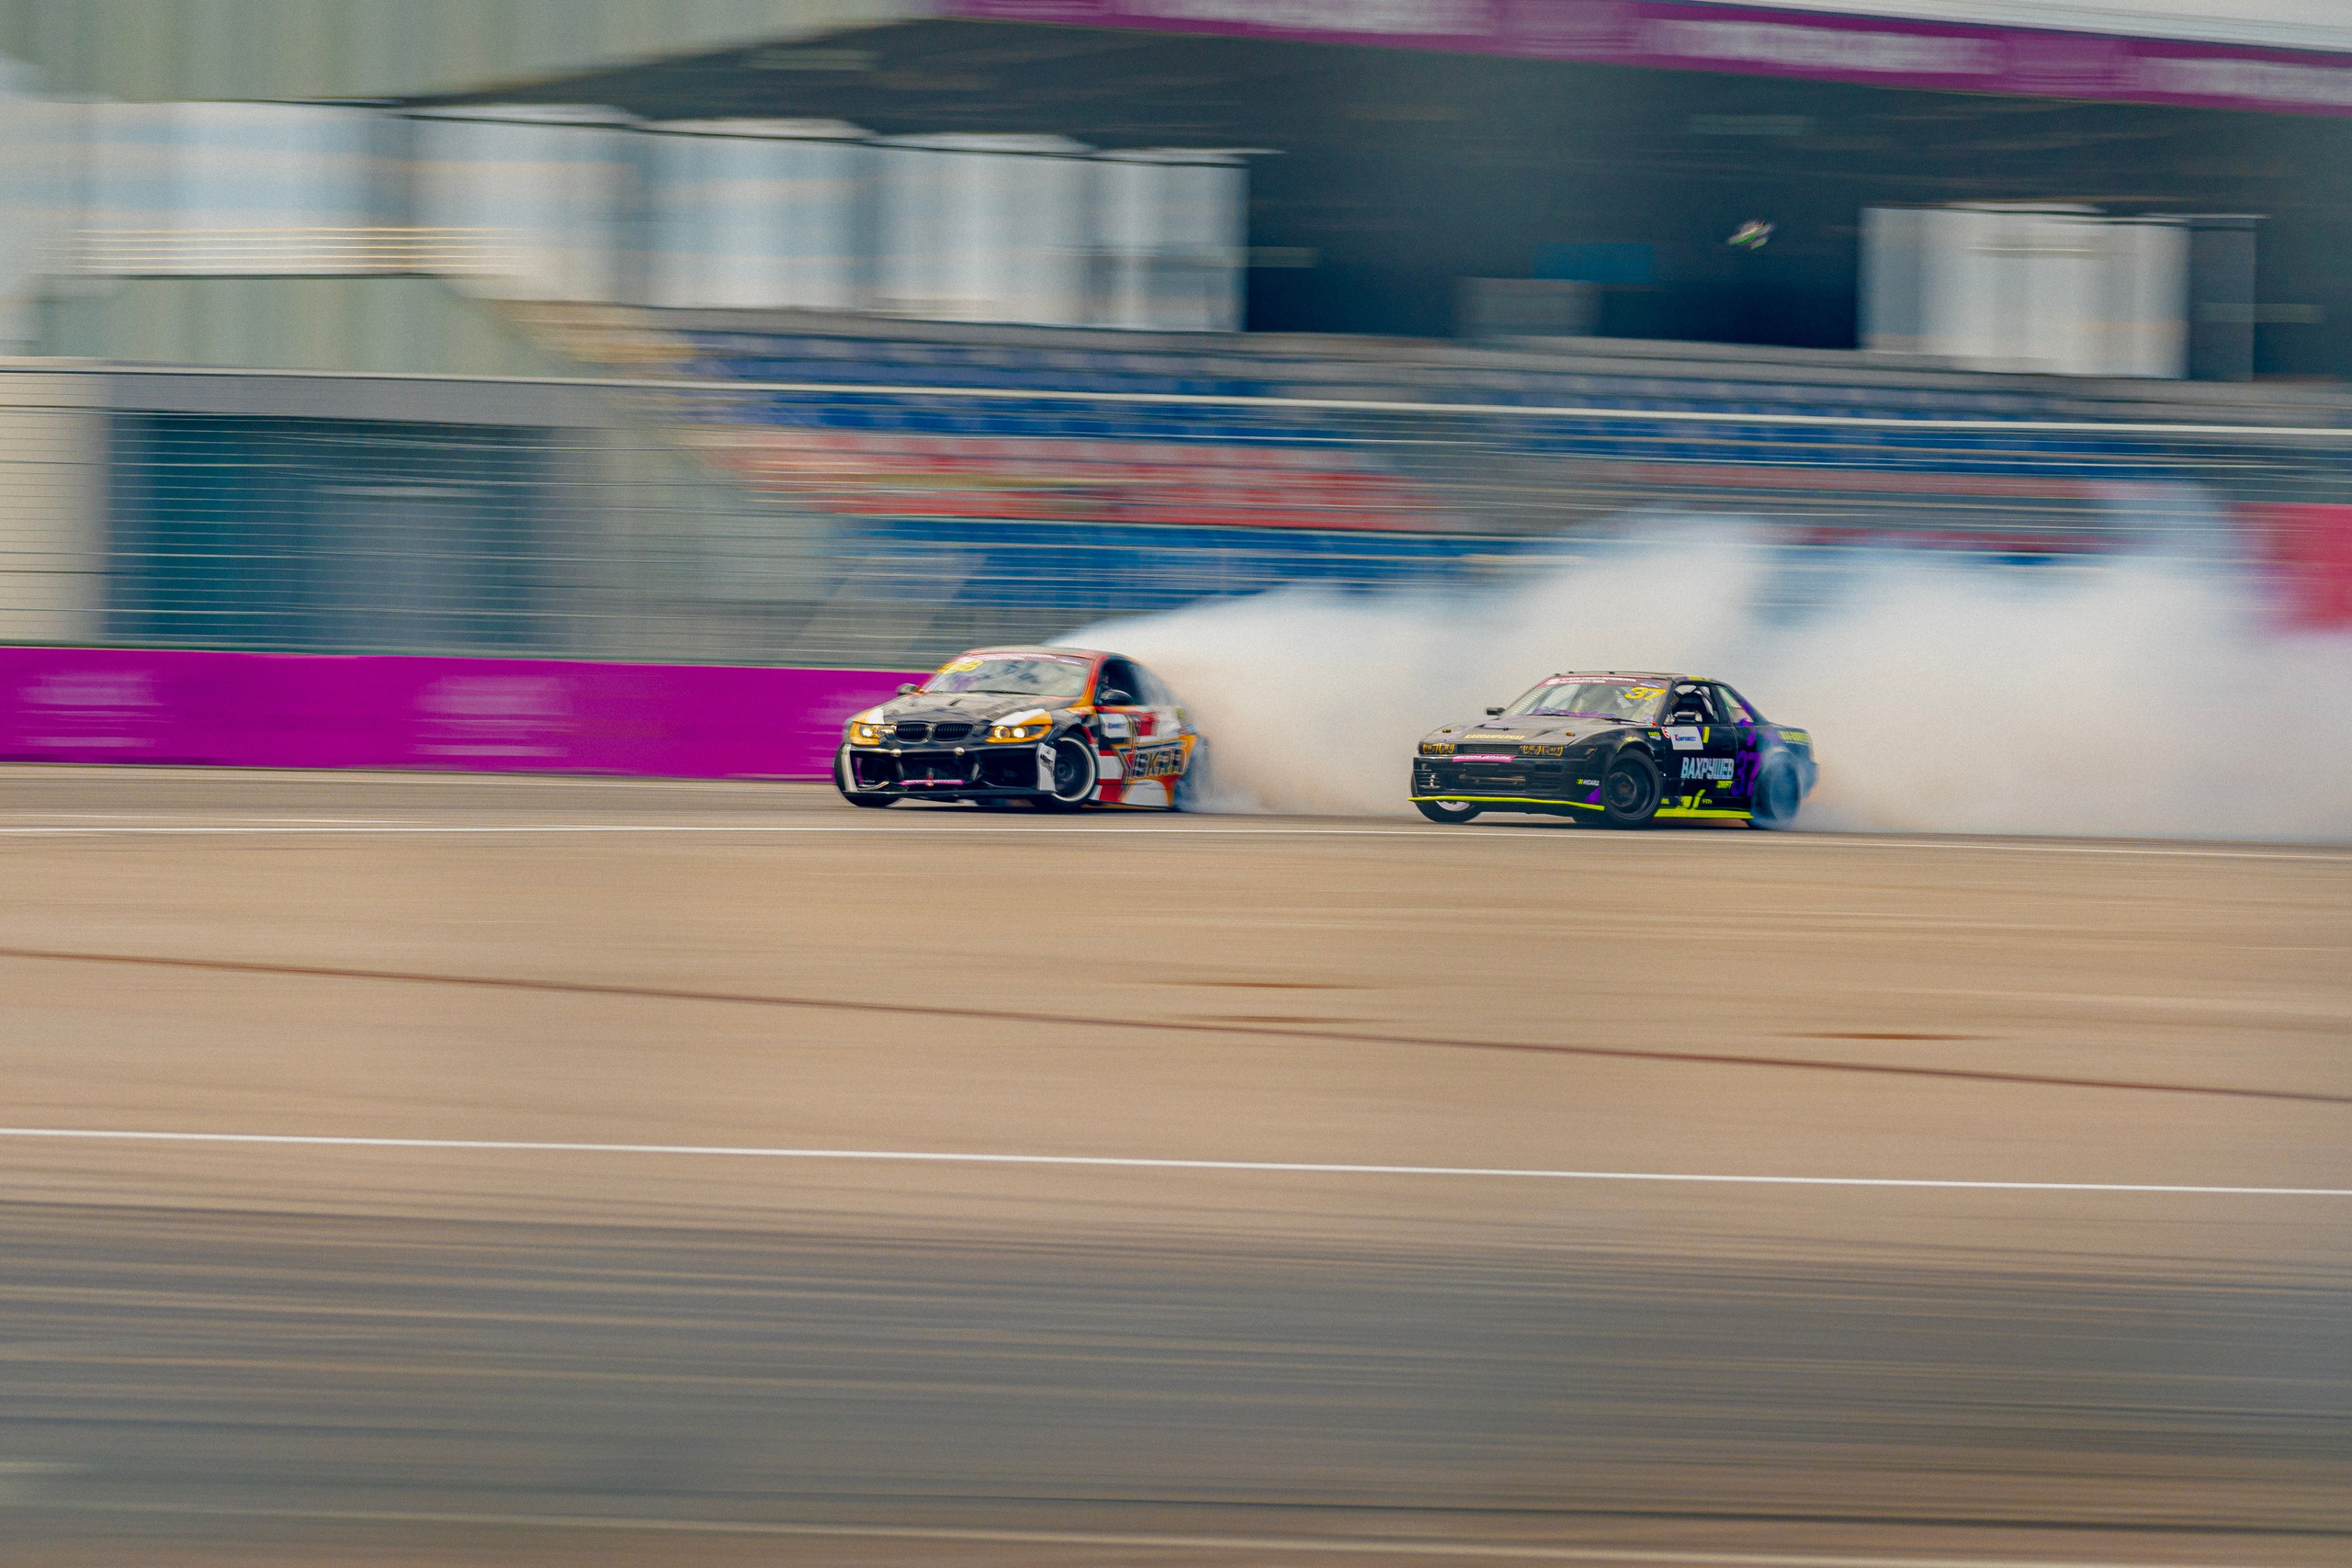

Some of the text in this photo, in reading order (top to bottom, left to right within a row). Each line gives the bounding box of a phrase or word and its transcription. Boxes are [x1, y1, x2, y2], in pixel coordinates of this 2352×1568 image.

[1624, 686, 1667, 701] 37
[1680, 756, 1735, 780] ВАХРУШЕВ
[1731, 750, 1763, 797] 37
